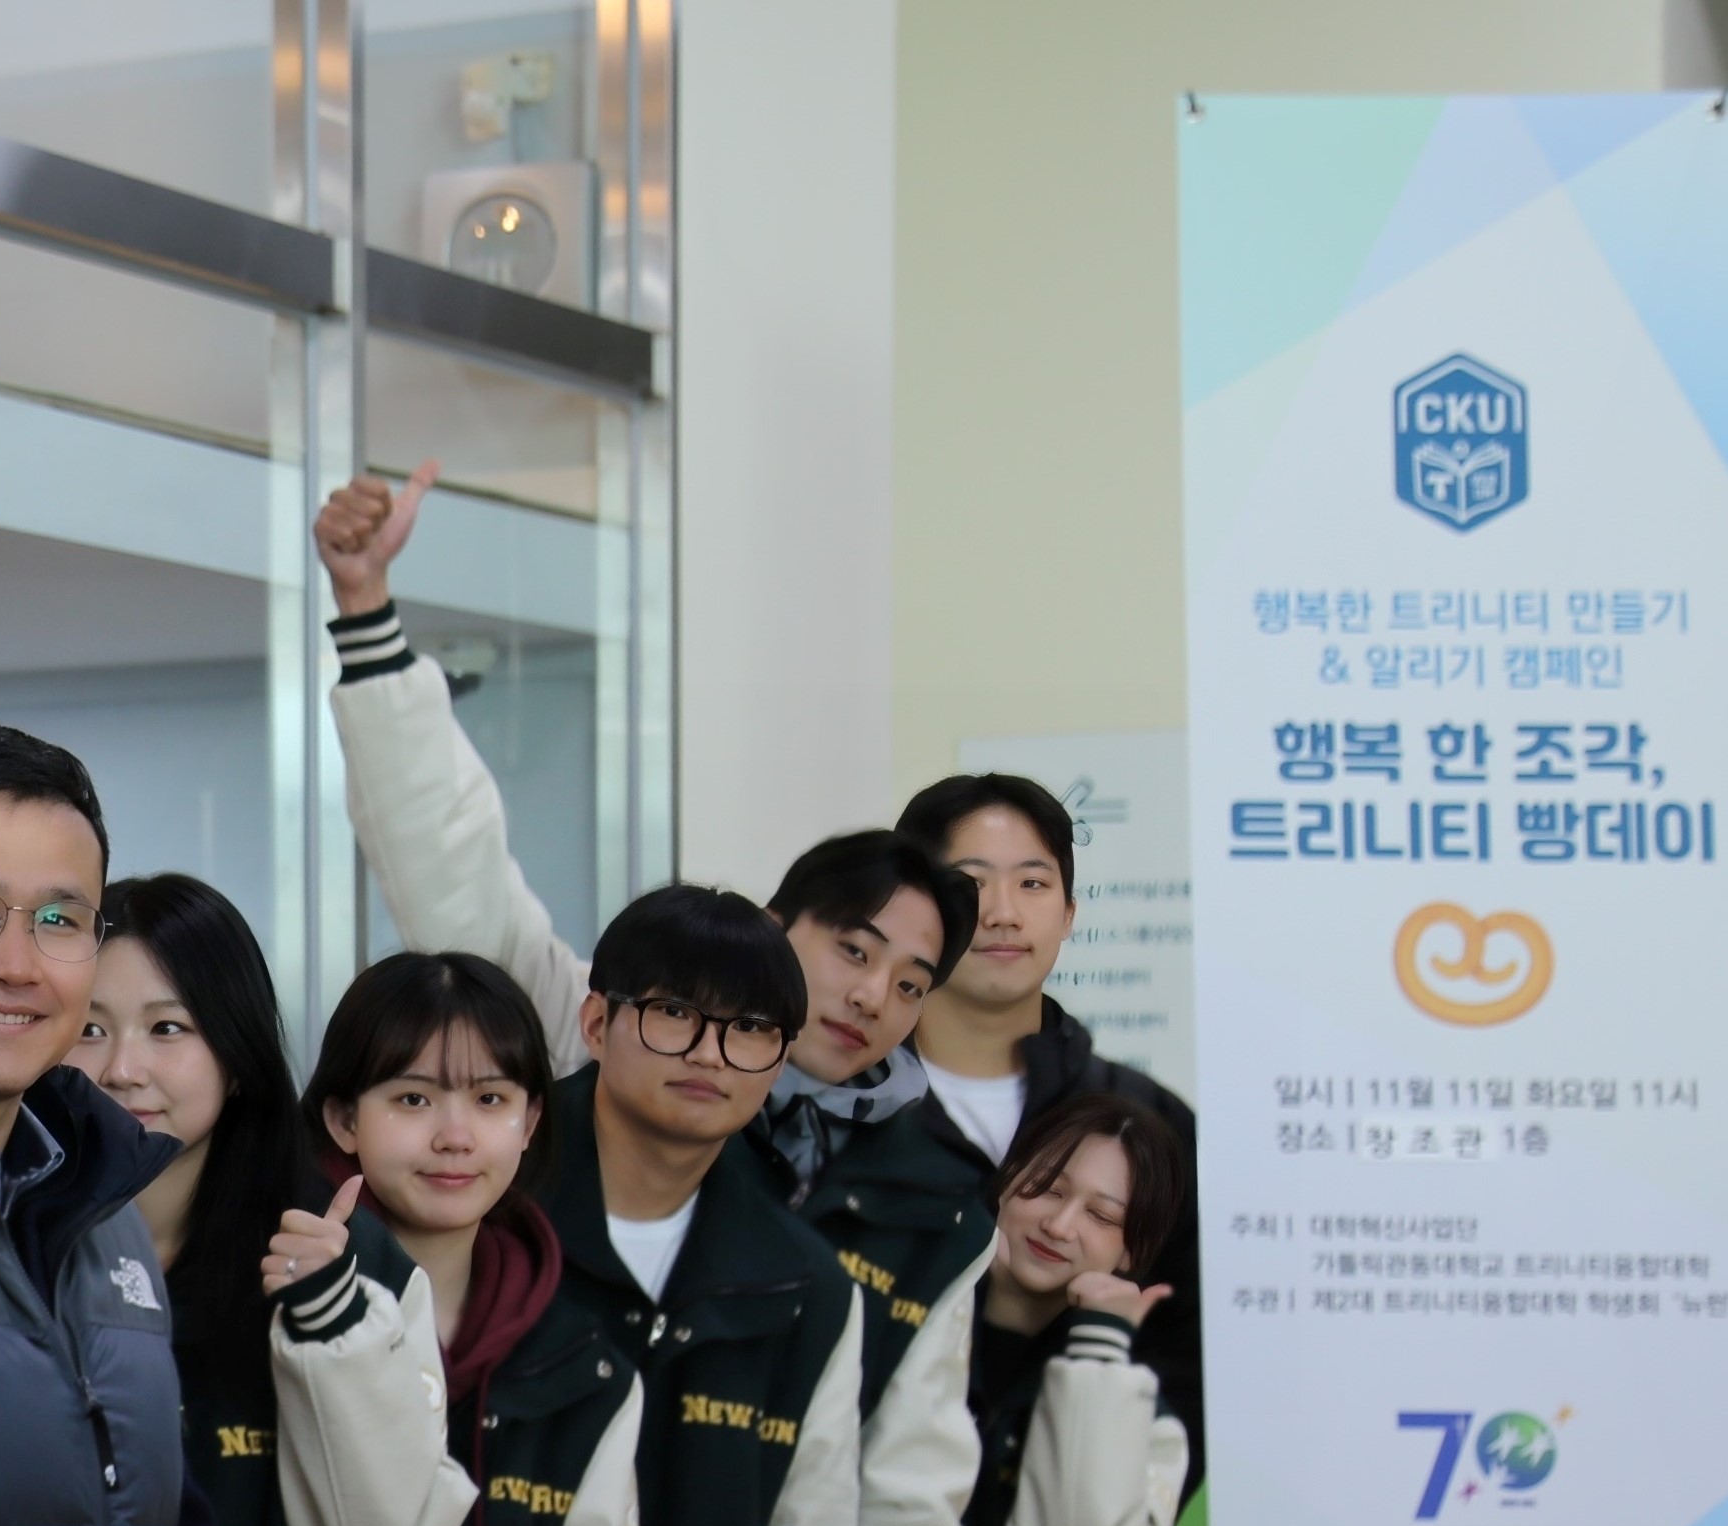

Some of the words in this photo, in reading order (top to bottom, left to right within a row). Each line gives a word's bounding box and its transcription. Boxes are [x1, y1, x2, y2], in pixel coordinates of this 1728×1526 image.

[1414, 392, 1508, 434] CKU
[1254, 590, 1373, 635] 행복한
[1389, 591, 1550, 633] 트리니티
[1567, 590, 1689, 634] 만들기
[1319, 645, 1350, 685] &
[1365, 644, 1486, 689] 알리기
[1504, 644, 1623, 689] 캠페인
[1272, 720, 1404, 785] 행복
[1426, 720, 1494, 785] 한
[1514, 720, 1667, 790] 조각,
[1228, 798, 1493, 864] 트리니티
[1515, 799, 1717, 864] 빵데이
[1273, 1077, 1334, 1109] 일시
[1368, 1078, 1435, 1110] 11월
[1448, 1078, 1514, 1110] 11일
[1526, 1079, 1618, 1111] 화요일
[1631, 1079, 1699, 1110] 11시
[1276, 1121, 1334, 1153] 장소
[1502, 1123, 1550, 1156] 1층
